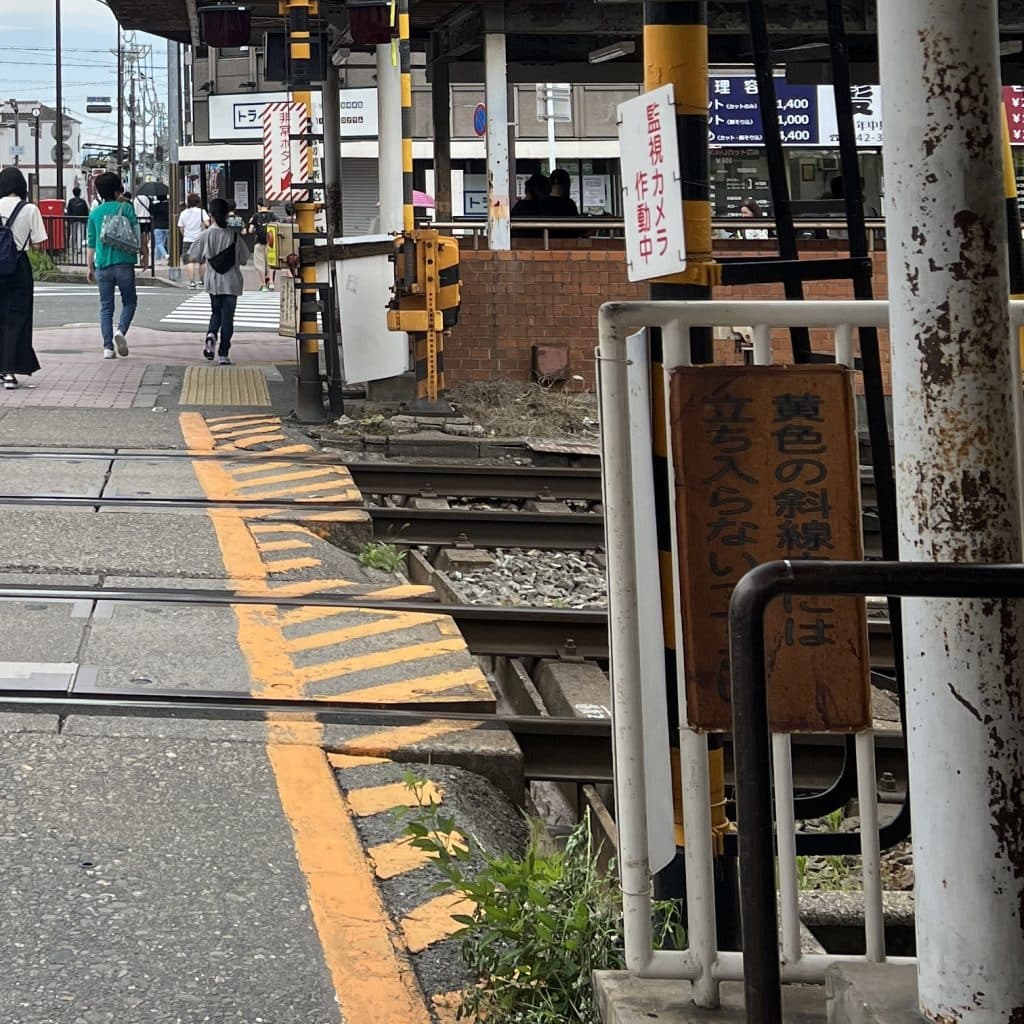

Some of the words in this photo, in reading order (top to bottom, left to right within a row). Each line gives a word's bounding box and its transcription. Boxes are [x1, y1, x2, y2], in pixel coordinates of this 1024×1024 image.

[714, 80, 758, 94] 理容
[634, 170, 654, 265] 作動中
[646, 103, 669, 257] 監視カメラ
[771, 392, 835, 647] 黄色の斜線には
